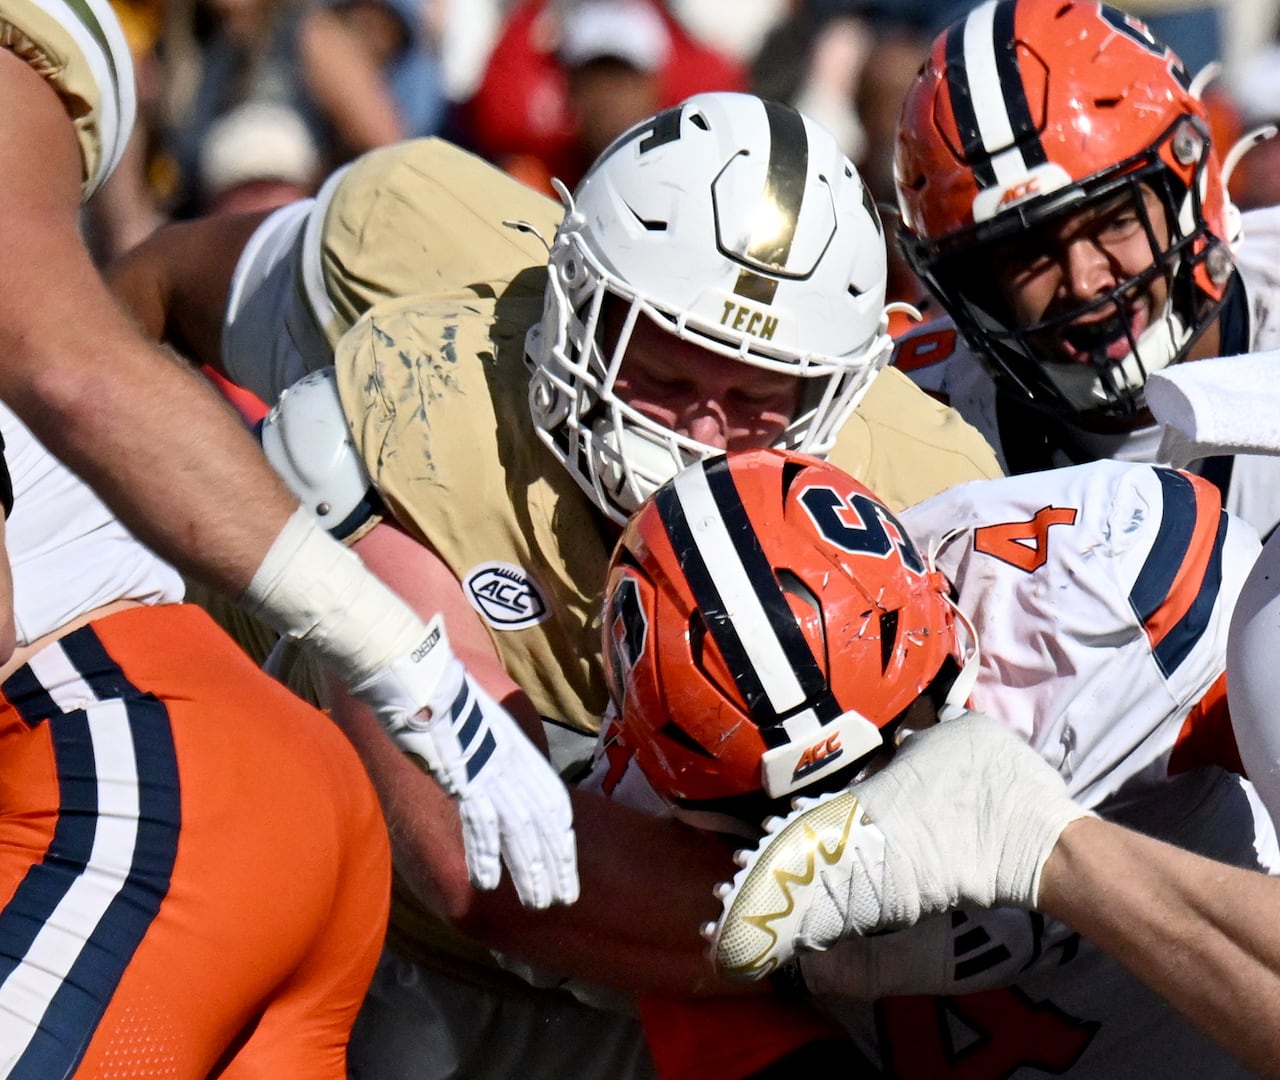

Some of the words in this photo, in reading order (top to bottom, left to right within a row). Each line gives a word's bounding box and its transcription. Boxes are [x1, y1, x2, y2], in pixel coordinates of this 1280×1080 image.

[720, 300, 779, 341] TECH
[796, 485, 928, 577] S
[974, 504, 1078, 574] 4
[478, 579, 534, 612] ACC
[796, 731, 842, 770] ACC
